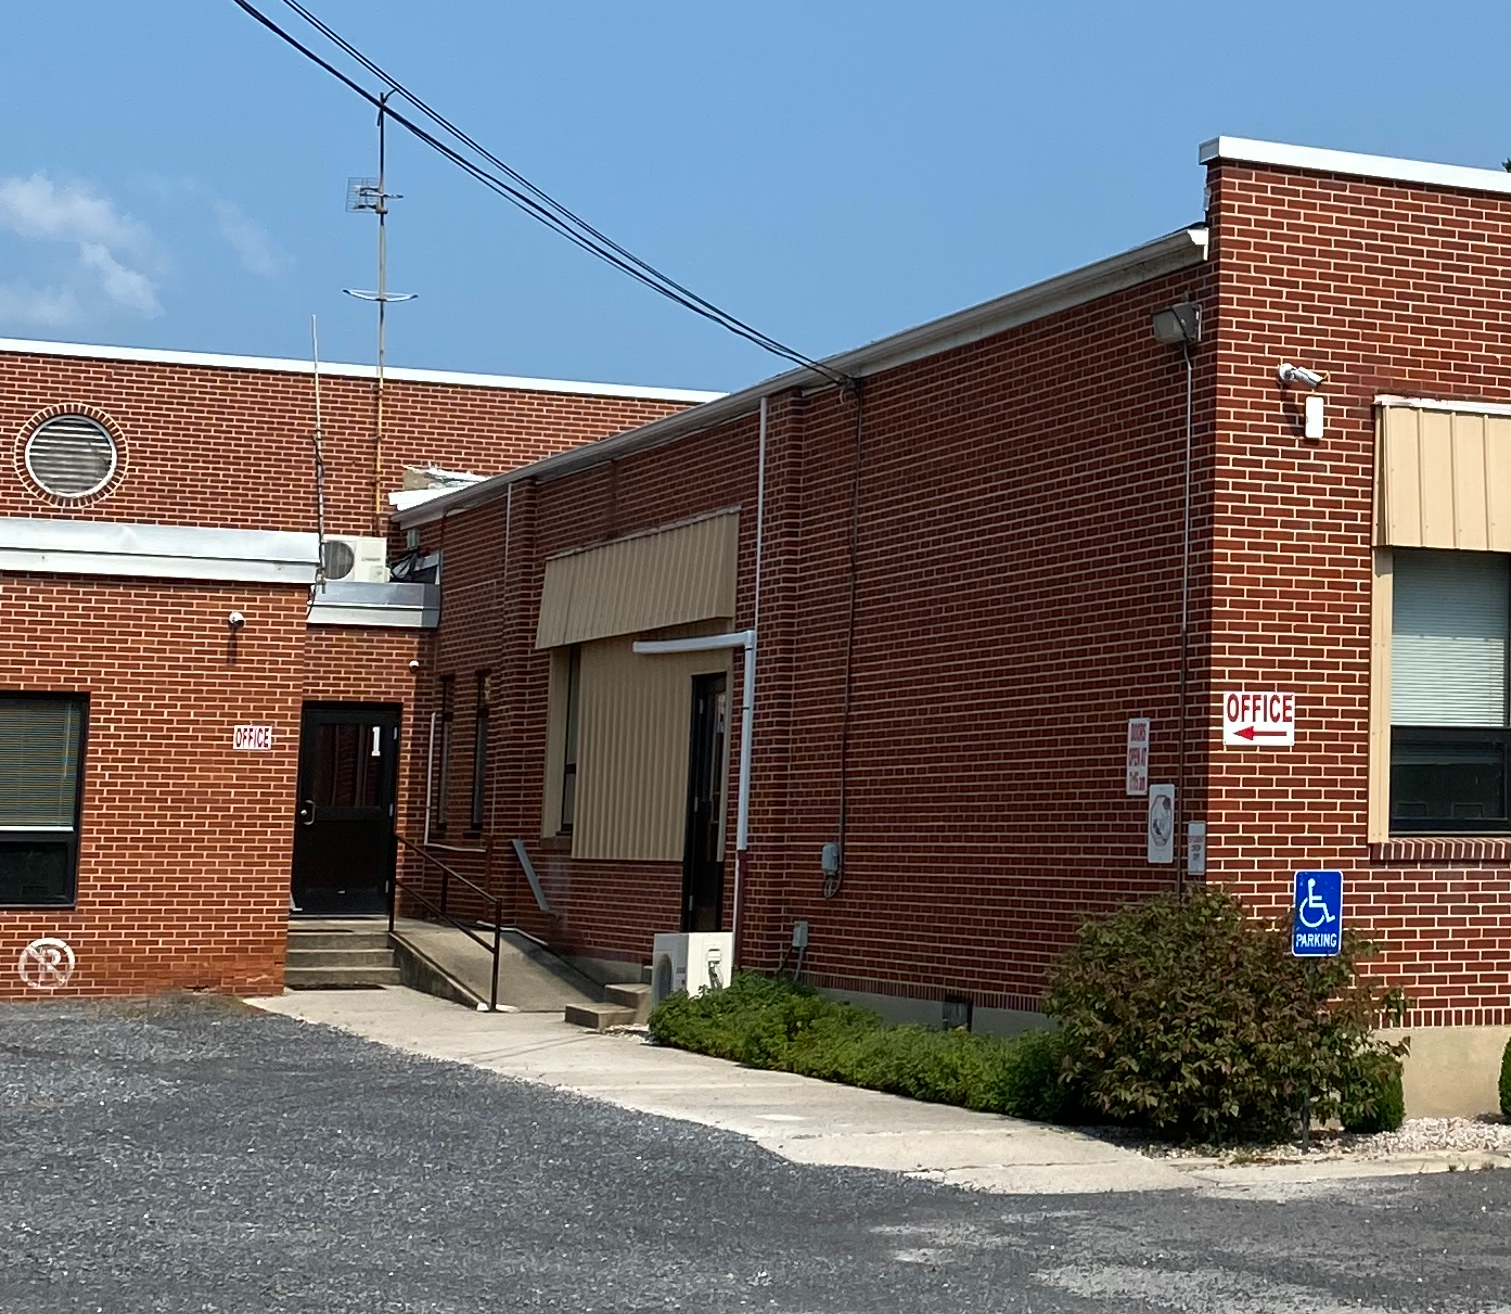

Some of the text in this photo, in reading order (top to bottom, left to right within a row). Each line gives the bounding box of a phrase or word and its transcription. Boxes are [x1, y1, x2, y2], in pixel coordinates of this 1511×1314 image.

[1226, 693, 1293, 723] OFFICE
[235, 727, 269, 748] OFFICE
[371, 726, 381, 757] 1
[1295, 933, 1338, 948] PARKING
